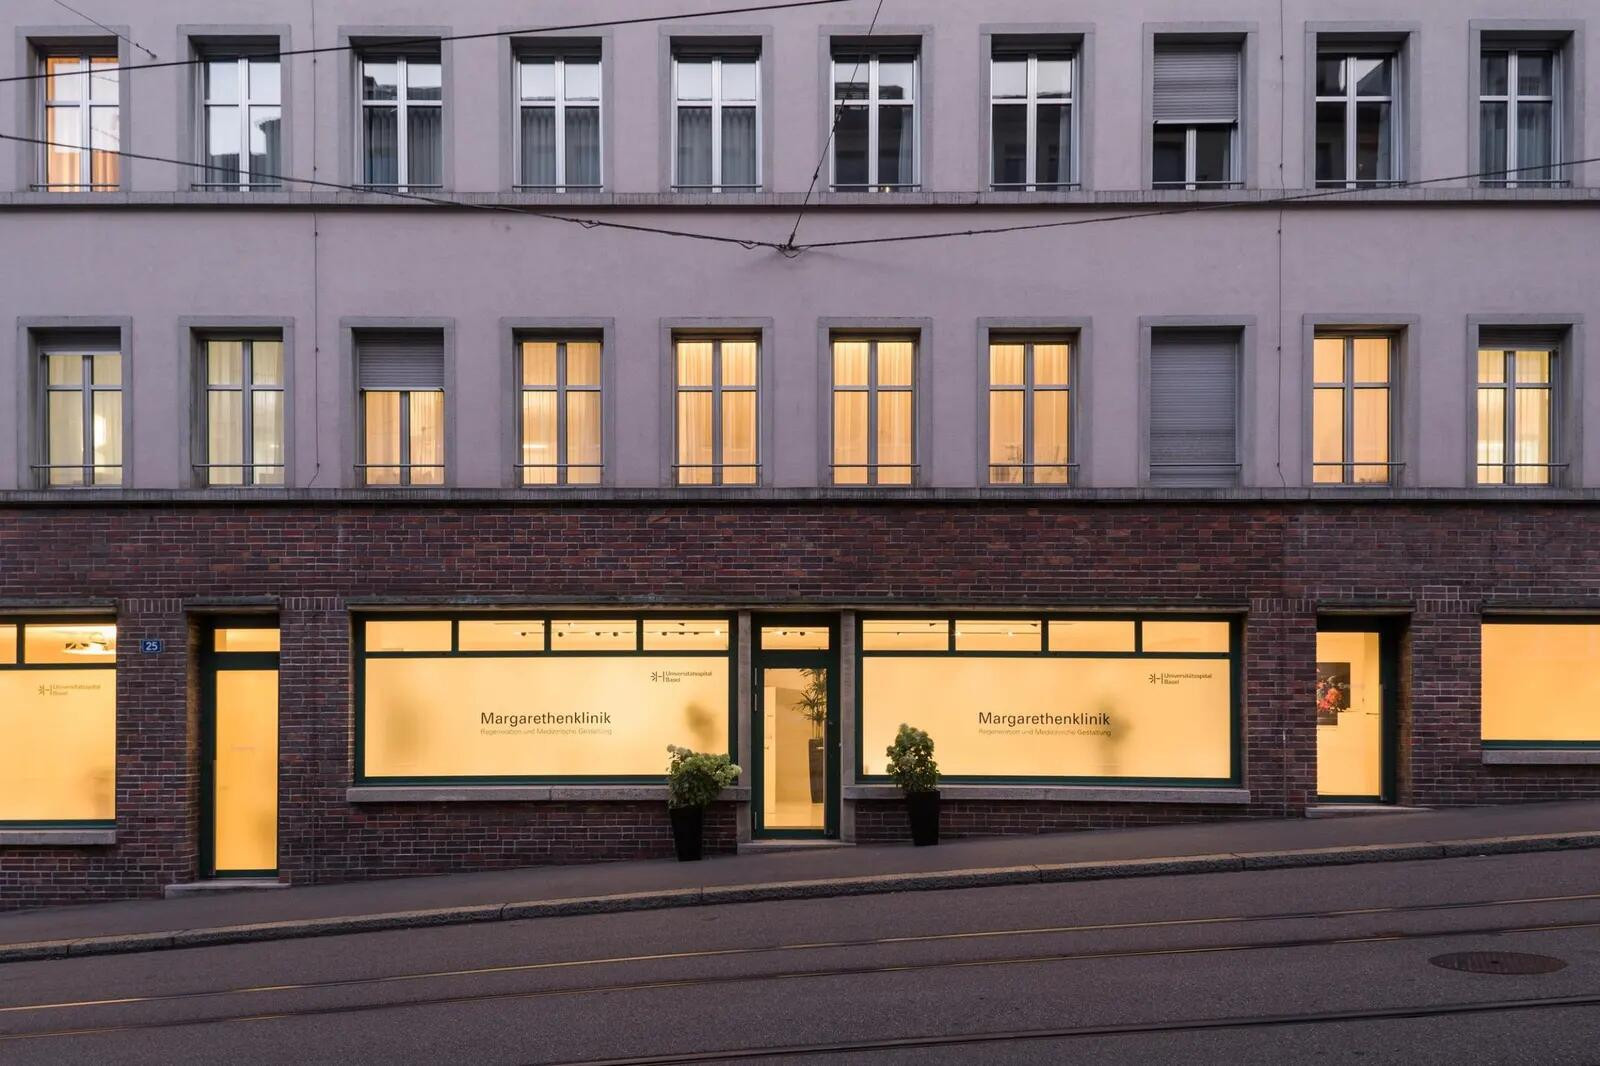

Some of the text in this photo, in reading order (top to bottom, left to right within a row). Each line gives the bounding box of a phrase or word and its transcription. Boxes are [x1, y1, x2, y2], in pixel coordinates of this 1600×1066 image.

[145, 641, 158, 651] 25
[480, 711, 612, 727] Margarethenklinik
[978, 711, 1111, 727] Margarethenklinik
